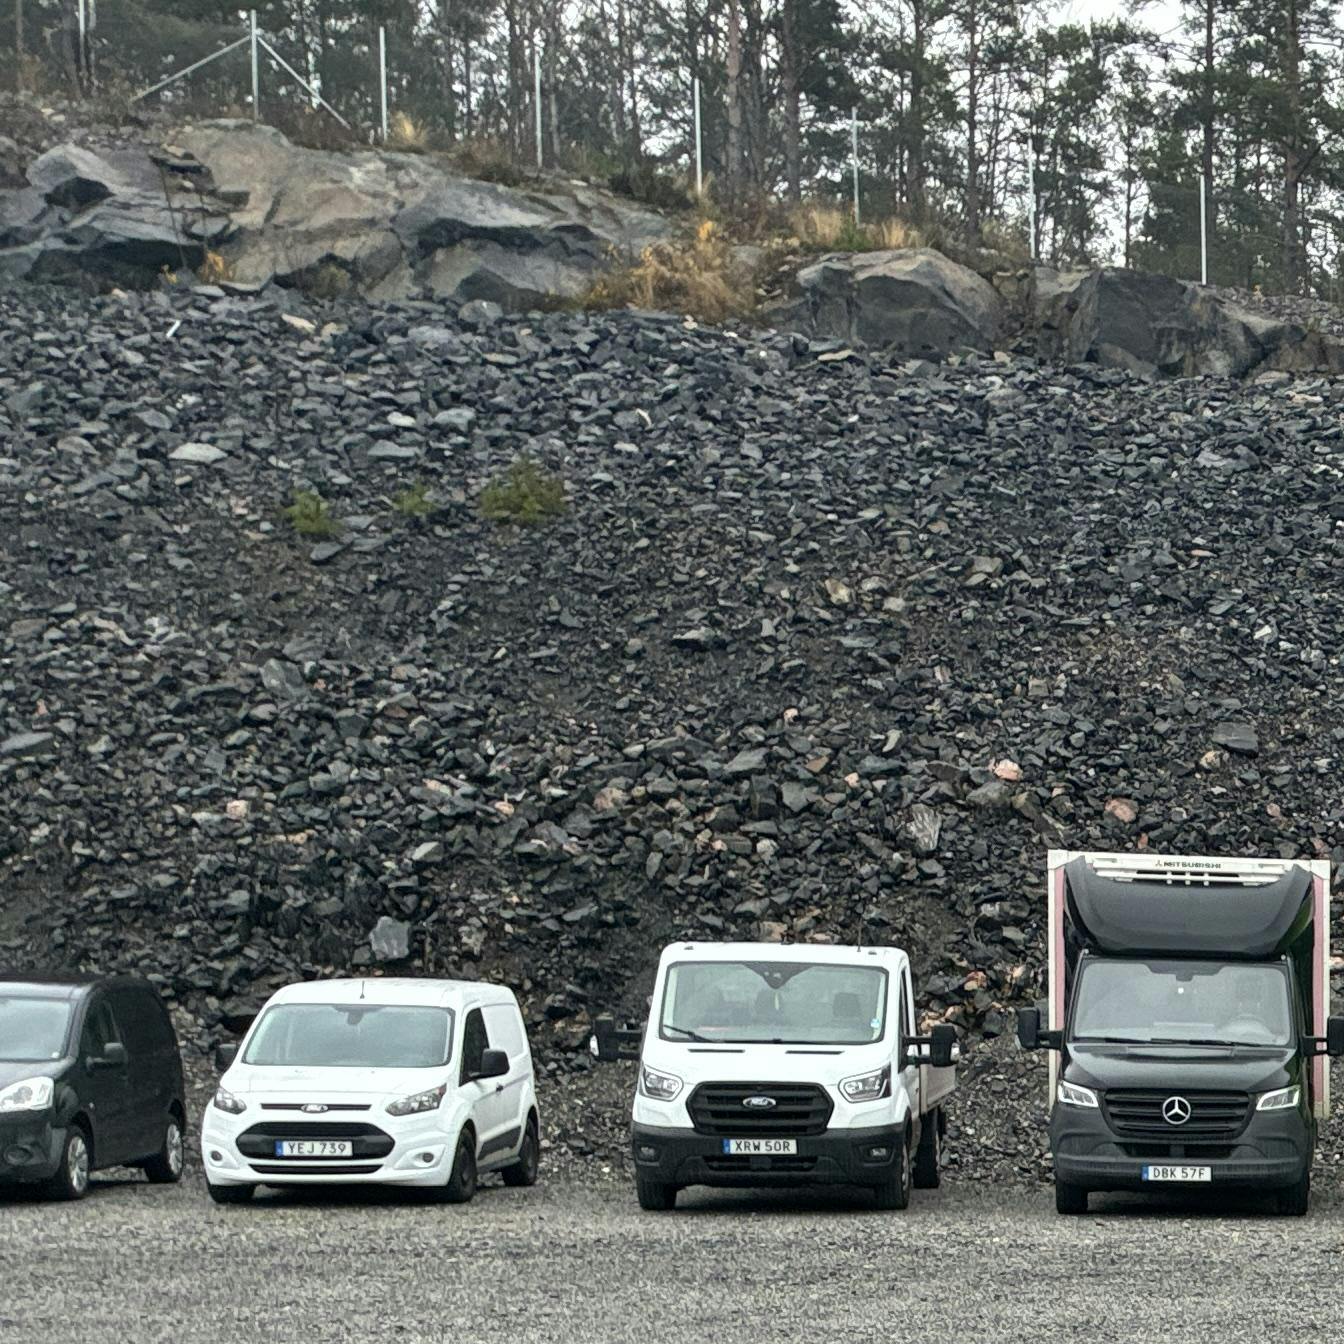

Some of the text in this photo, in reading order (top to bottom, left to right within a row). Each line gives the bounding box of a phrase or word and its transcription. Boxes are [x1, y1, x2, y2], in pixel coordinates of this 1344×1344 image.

[287, 1142, 347, 1154] YEJ 739
[735, 1140, 761, 1152] XRW
[1153, 1167, 1205, 1179] DBK 57F
